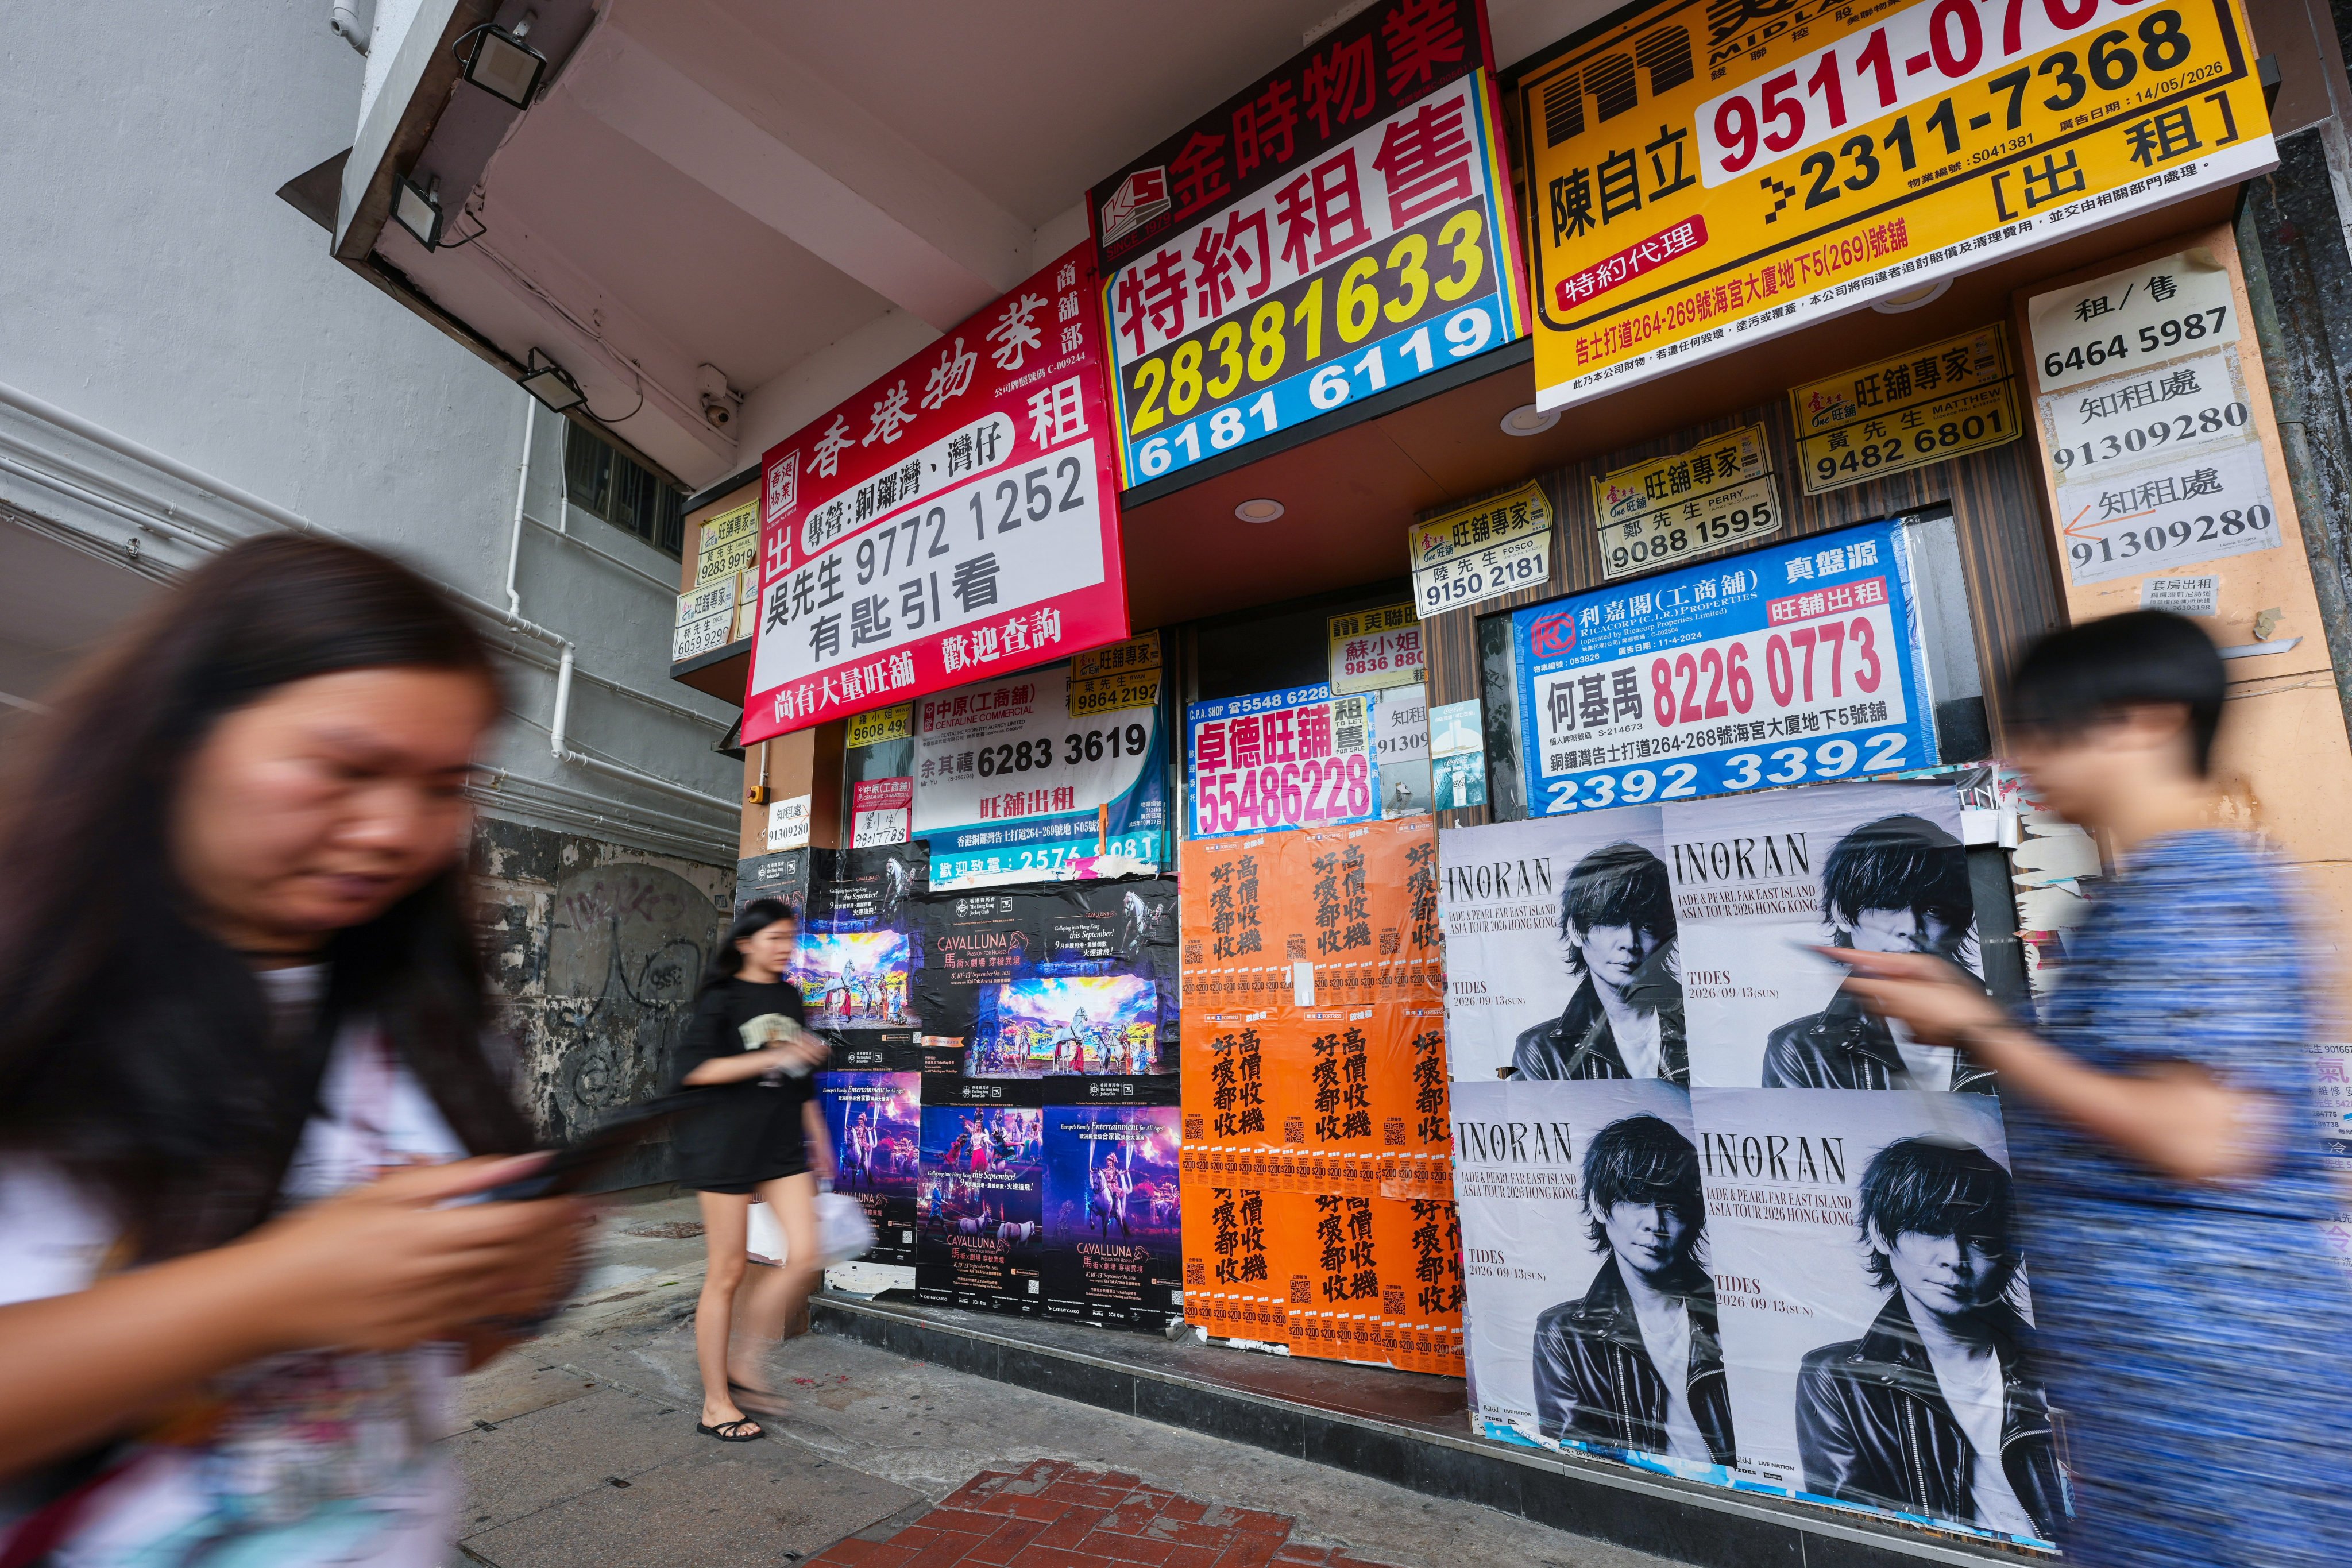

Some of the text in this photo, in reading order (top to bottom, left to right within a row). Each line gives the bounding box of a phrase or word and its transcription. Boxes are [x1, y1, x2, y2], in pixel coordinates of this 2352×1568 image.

[1714, 0, 2144, 173] 9511-07
[1799, 9, 2191, 210] 2311-7368
[2059, 61, 2223, 132] 廣告日期：14/05/2026
[1168, 0, 1466, 222] 金時物業
[1548, 125, 1696, 248] 陳自立
[1107, 211, 1171, 259] SINCE 1979
[1118, 94, 1473, 356] 特約租售
[1566, 222, 1697, 303] 特約代理
[1056, 260, 1083, 354] 商舖部
[1574, 216, 1909, 366] 告士打道264-269號海宮大廈地下5(269)號舖
[2073, 276, 2178, 323] 租/售
[1131, 210, 1484, 437] 28381633
[2044, 335, 2128, 378] 6464
[2139, 306, 2229, 353] 5987
[807, 293, 1048, 479] 香港物業
[995, 351, 1086, 398] 公司牌照號碼 C-009244
[1139, 308, 1492, 476] 6181 6119
[1854, 346, 1973, 408] 旺舖專家
[2080, 369, 2202, 425] 知租處
[1028, 374, 1088, 449] 租
[1828, 387, 2002, 453] 黃先生 MATTHEW
[1817, 409, 2003, 480] 9482 6801
[2053, 401, 2249, 474] 91309280
[808, 421, 1002, 548] 專營:銅鑼灣、灣仔
[1644, 446, 1741, 501] 旺舖專家
[2098, 468, 2224, 521] 知租處
[718, 512, 750, 540] 旺舖專家
[1452, 501, 1530, 548] 旺舖專家
[1612, 501, 1772, 568] 9088 1595
[1623, 489, 1744, 540] 鄭先生 PERRY
[2071, 504, 2272, 570] 91309280
[702, 548, 752, 579] 9283 9919
[707, 539, 751, 563] 黃先生 SAMUEL
[765, 525, 791, 584] 出
[766, 455, 1084, 635] 吳先生 9772 1252
[1434, 540, 1534, 583] 陸先生 FOSCO
[695, 587, 725, 615] 旺舖專家
[1427, 553, 1543, 606] 9150 2181
[1578, 539, 1879, 628] 利嘉閣(工商舖) 真盤源
[1771, 581, 1883, 623] 旺舖出租
[2153, 579, 2211, 590] 套房出租
[684, 615, 723, 639] 林先生 DICK
[808, 551, 1000, 663] 有匙引看
[1580, 619, 1637, 637] RICACORP
[1581, 608, 1727, 645] (operated by Ricacorp Properties Limited)
[679, 636, 701, 655] 6059
[774, 607, 1061, 724] 尚有大量旺舖 歡迎查詢
[1100, 643, 1149, 670] 旺舖專家
[1345, 631, 1420, 661] 蘇小姐
[1345, 656, 1388, 675] 9836
[1533, 632, 1702, 673] 物業編號：053826 廣告日期：11-4-2024
[1079, 690, 1117, 710] 9864
[1122, 683, 1157, 702] 2192
[1084, 676, 1127, 693] 葉先生
[1548, 616, 1882, 735] 何基禹 8226 0773
[859, 709, 893, 725] 羅小姐
[936, 684, 1036, 719] 中原(工商舖)
[936, 705, 1034, 729] CENTALINE COMMERCIAL
[1189, 686, 1328, 721] C.P.A. SHOP 5548 6228
[1334, 697, 1362, 721] 租
[854, 723, 884, 740] 9608
[921, 723, 1146, 778] 余其禧 6283 3619
[1197, 704, 1331, 774] 卓德旺舖
[1335, 725, 1364, 749] 售
[1550, 723, 1643, 746] 個人牌照號碼 S-214673
[1550, 700, 1887, 774] 銅鑼灣告士打道264-268號海宮大廈地下5號舖
[864, 782, 911, 794] 中原(工商舖)
[948, 773, 974, 782] (S-396704)
[1199, 754, 1370, 834] 55486228
[1546, 732, 1908, 813] 2392 3392
[777, 804, 801, 821] 知租處
[979, 786, 1075, 820] 旺舖出租
[1129, 819, 1161, 827] 2025年10月27日
[769, 822, 808, 842] 91309280
[856, 828, 905, 848] 98017788
[1447, 858, 1551, 903] INORAN
[1671, 832, 1809, 886] INORAN
[937, 933, 1007, 951] CAVALLUNA
[1070, 929, 1114, 940] this September!
[1315, 979, 1328, 988] $200
[1211, 1034, 1238, 1138] 好壞都收
[1238, 1028, 1265, 1134] 高價收機
[1091, 1122, 1138, 1131] Entertainment
[1458, 1123, 1571, 1164] INORAN
[1701, 1133, 1845, 1185] INORAN
[1706, 1187, 1852, 1210] JADE & PEARL FAR EAST ISLAND
[1709, 1202, 1853, 1226] ASIA TOUR 2026 HONG KONG
[947, 1235, 995, 1249] CAVALLUNA
[1077, 1242, 1132, 1258] CAVALLUNA
[1714, 1275, 1760, 1294] TIDES
[1716, 1293, 1813, 1318] 2026/09/13(SUN)
